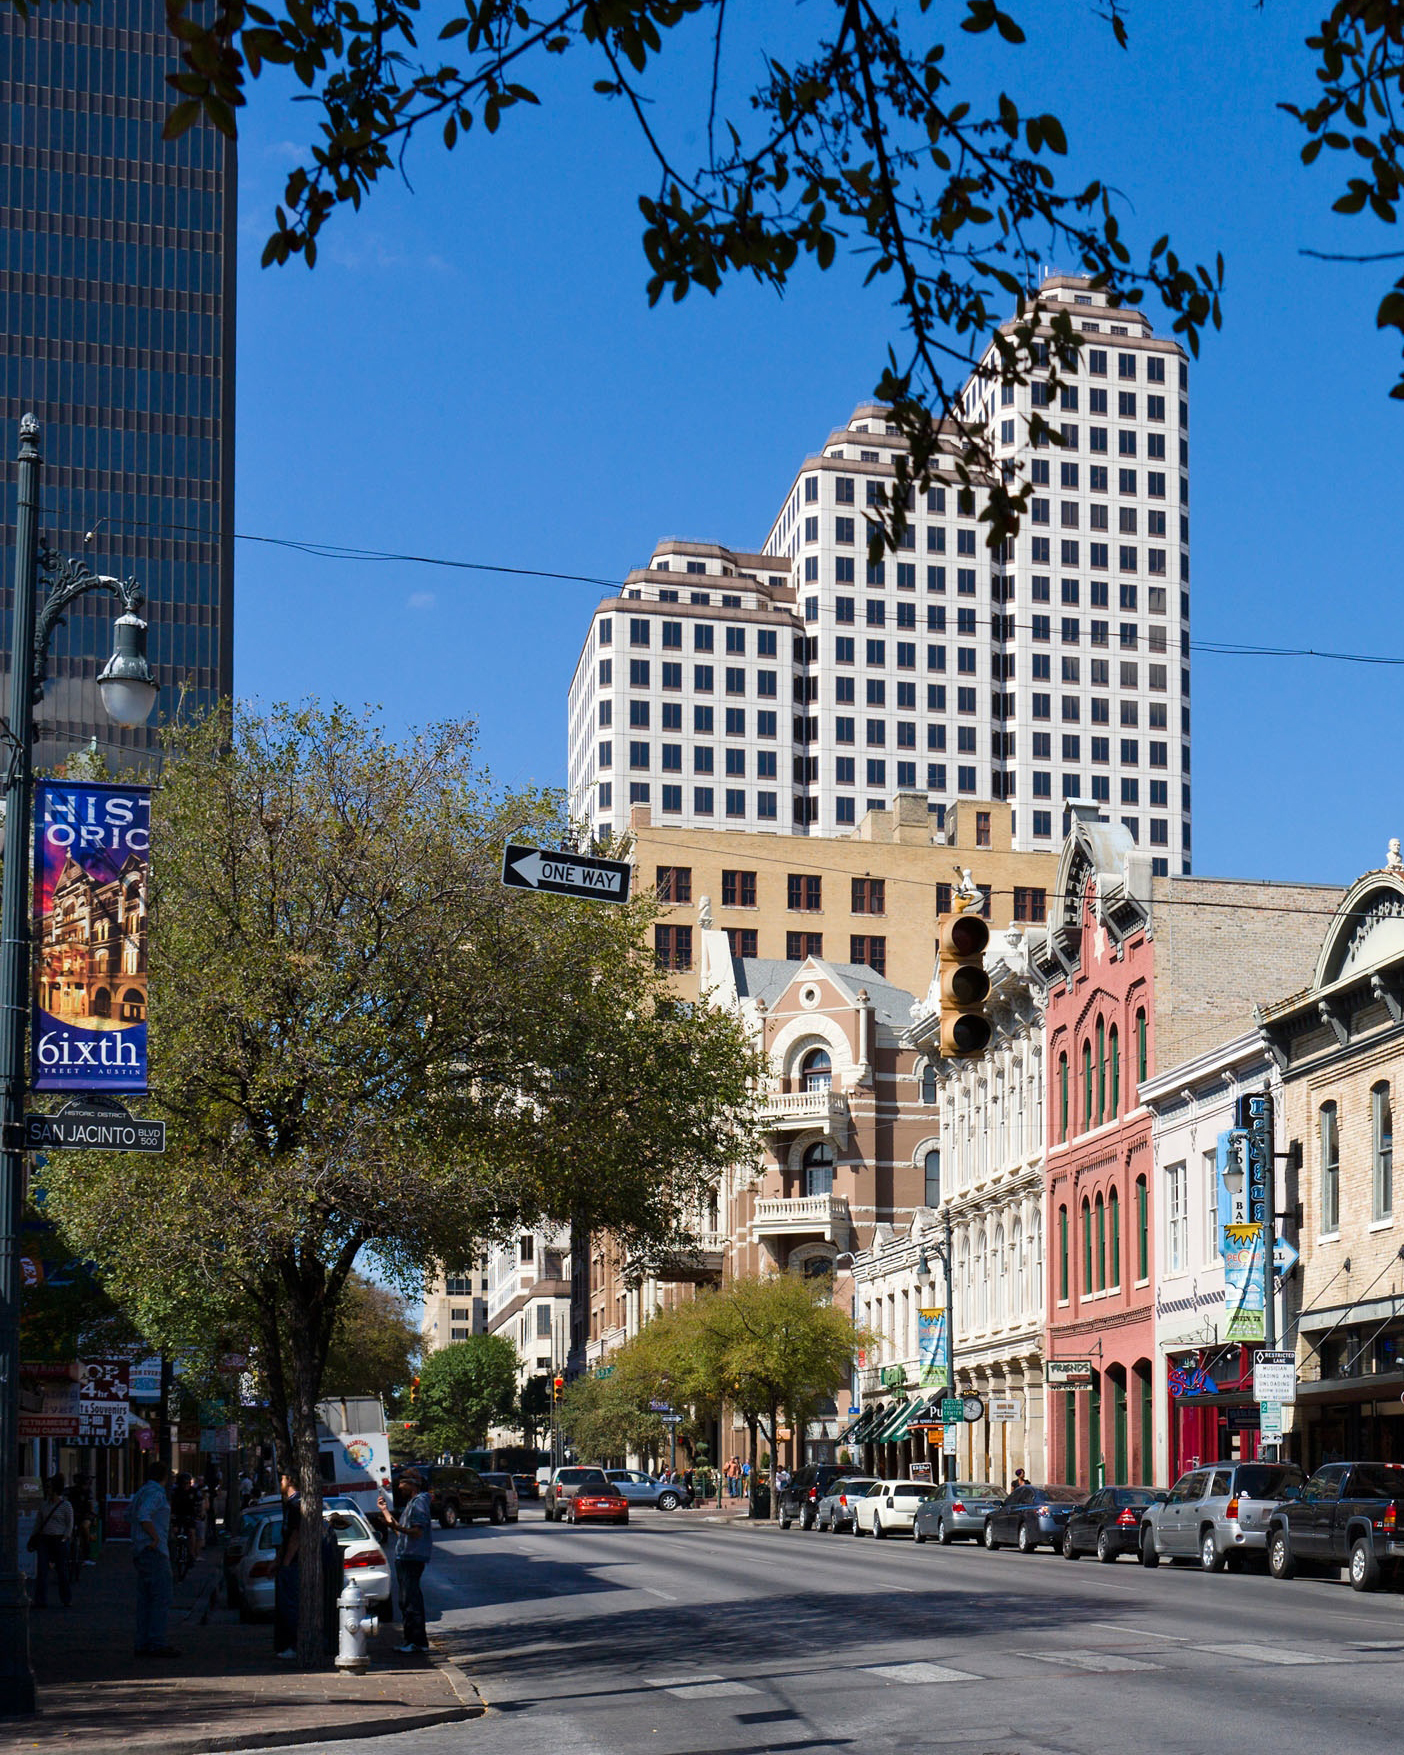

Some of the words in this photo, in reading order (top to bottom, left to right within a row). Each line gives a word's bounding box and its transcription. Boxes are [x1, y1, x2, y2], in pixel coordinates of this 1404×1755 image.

[47, 824, 150, 850] ORIC
[542, 863, 576, 883] ONE
[582, 869, 616, 889] WAY
[38, 1031, 140, 1066] 6ixth
[65, 1110, 95, 1118] HISTORIC
[30, 1123, 65, 1142] SAN
[67, 1125, 136, 1145] JACINTO
[138, 1128, 161, 1138] BLVD
[140, 1137, 158, 1146] 500
[1050, 1363, 1090, 1373] FRIENDS
[91, 1402, 127, 1415] Souvenirs
[1262, 1402, 1268, 1413] 2
[21, 1427, 39, 1435] THAI
[41, 1427, 74, 1435] CUISINE
[115, 1415, 126, 1437] ATM
